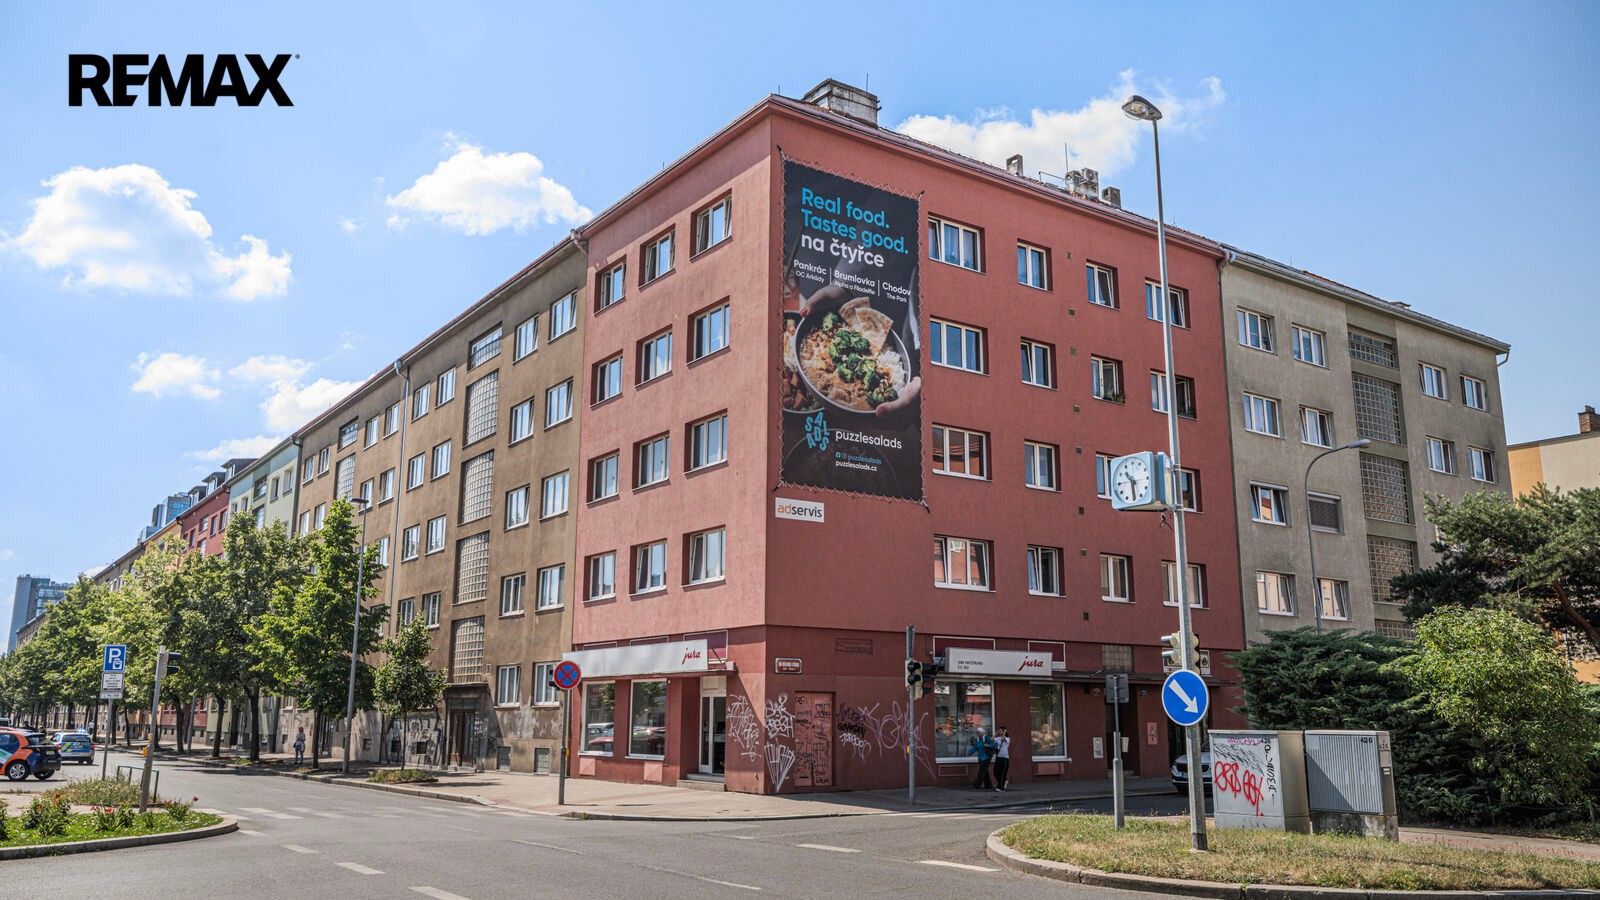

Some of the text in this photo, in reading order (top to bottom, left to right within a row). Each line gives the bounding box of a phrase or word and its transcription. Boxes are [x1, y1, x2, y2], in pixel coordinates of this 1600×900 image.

[801, 187, 890, 229] Real food.
[801, 208, 909, 254] Tastes good.
[801, 234, 885, 268] na čtyřce
[793, 259, 827, 275] Pankrác
[796, 270, 805, 278] OC
[834, 269, 875, 287] Brumlovka
[882, 282, 912, 296] Chodov
[886, 292, 896, 300] The
[835, 430, 902, 449] puzzlesalads
[835, 460, 878, 472] puzzlesalads.cz
[847, 454, 882, 465] puzzlesalads
[777, 503, 822, 518] adservis
[108, 647, 121, 664] P
[682, 647, 701, 665] jura
[1018, 656, 1043, 672] jura
